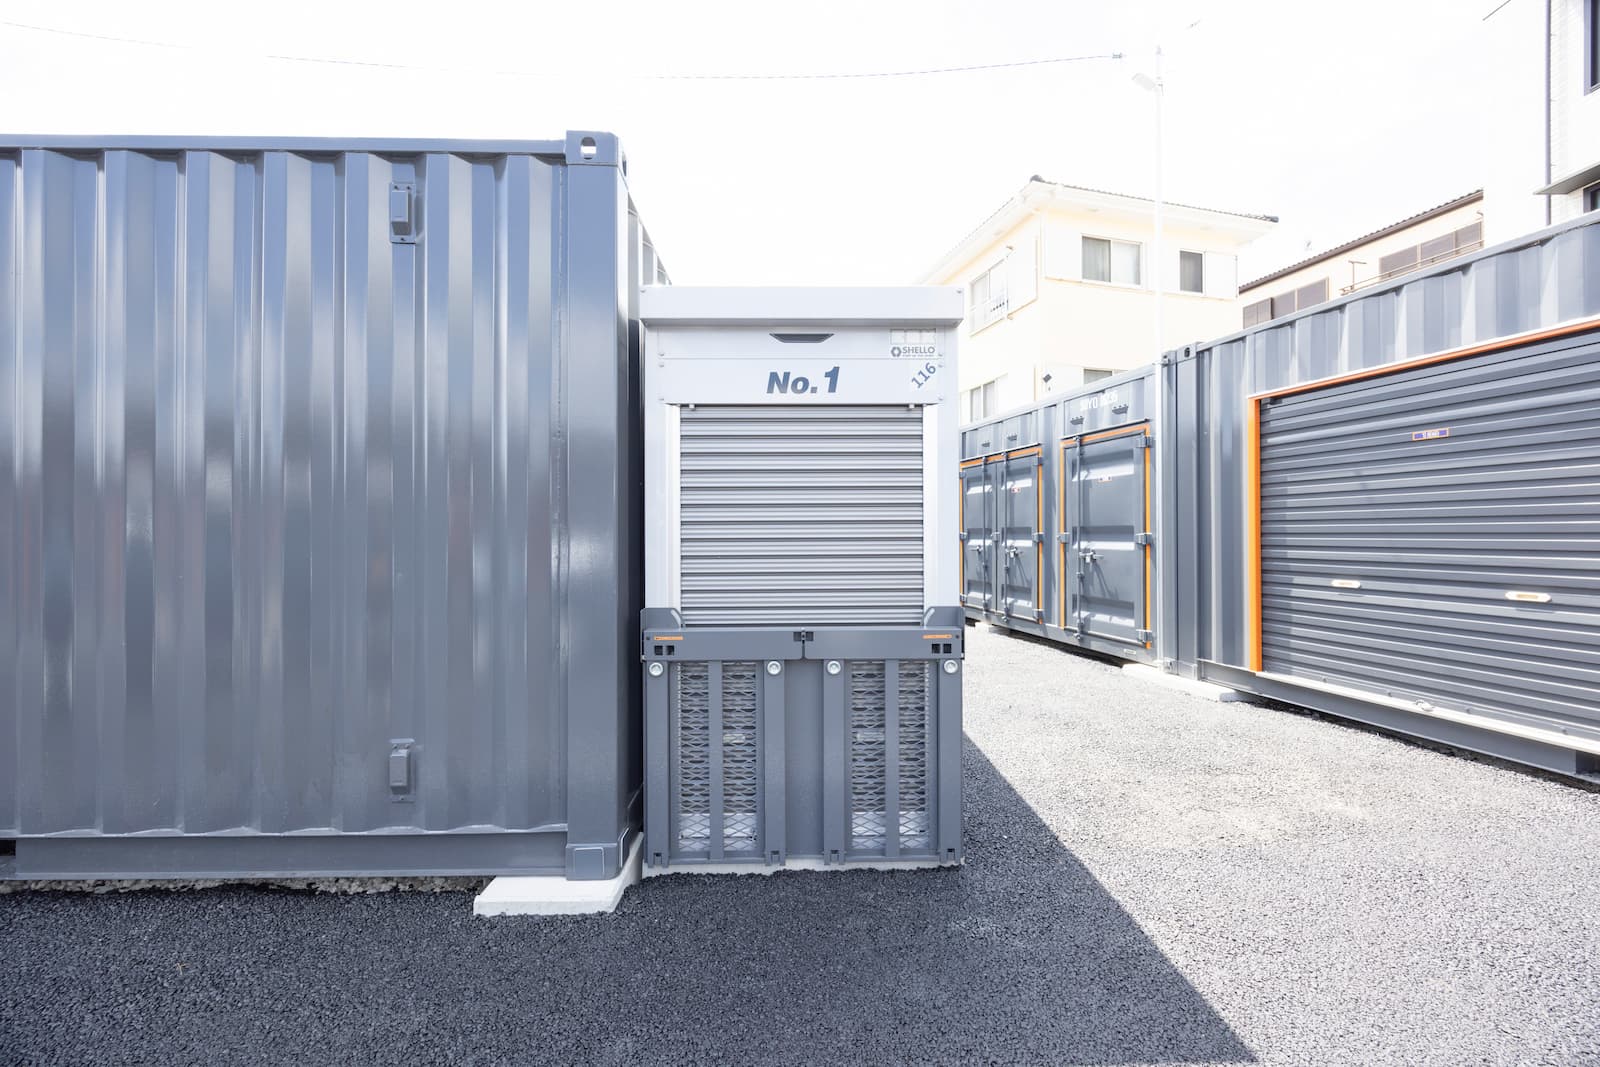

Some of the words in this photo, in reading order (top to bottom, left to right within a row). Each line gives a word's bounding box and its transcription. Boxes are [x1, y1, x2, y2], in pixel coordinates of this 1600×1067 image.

[902, 346, 936, 354] SHELLO
[766, 366, 840, 394] No.1
[911, 362, 936, 389] 116
